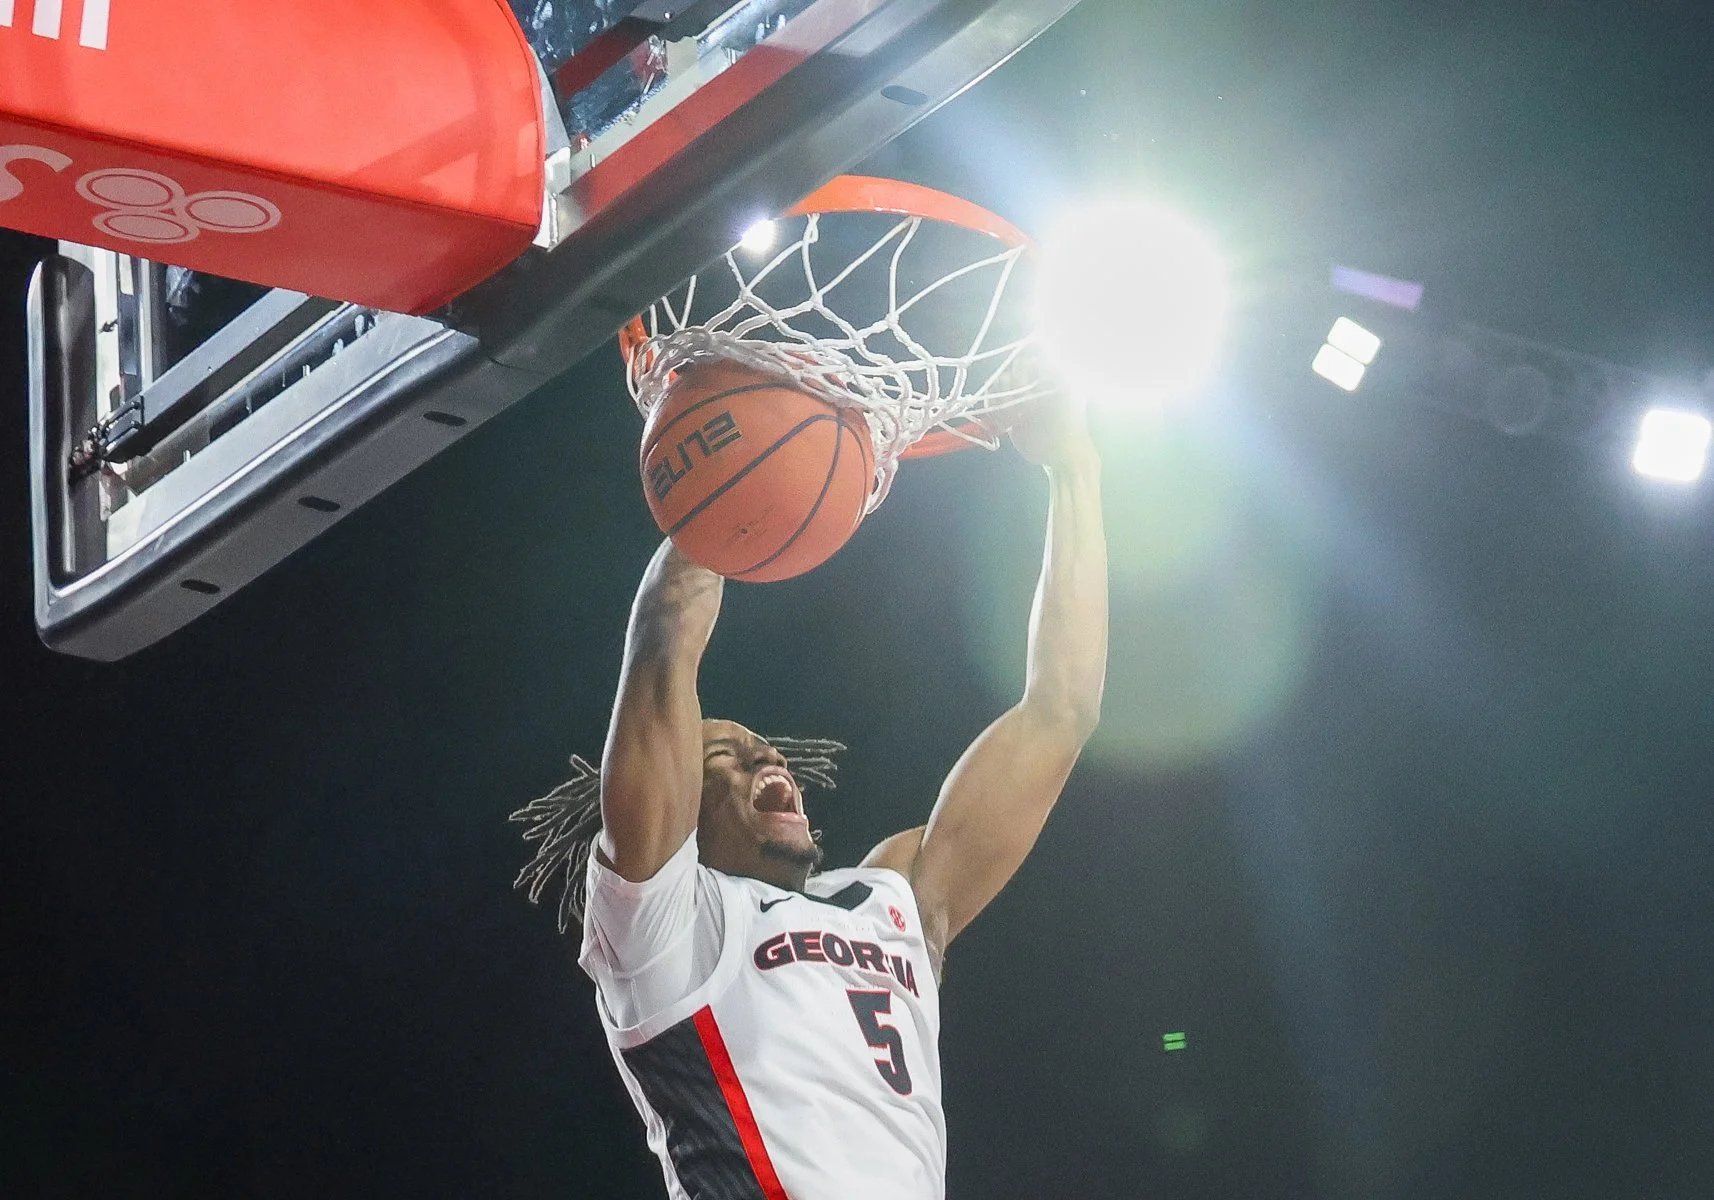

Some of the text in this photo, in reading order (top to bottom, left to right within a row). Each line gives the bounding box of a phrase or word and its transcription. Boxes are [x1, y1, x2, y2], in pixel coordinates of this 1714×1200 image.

[651, 410, 744, 502] ELITE
[753, 930, 920, 998] GEORIA
[845, 988, 913, 1096] 5
